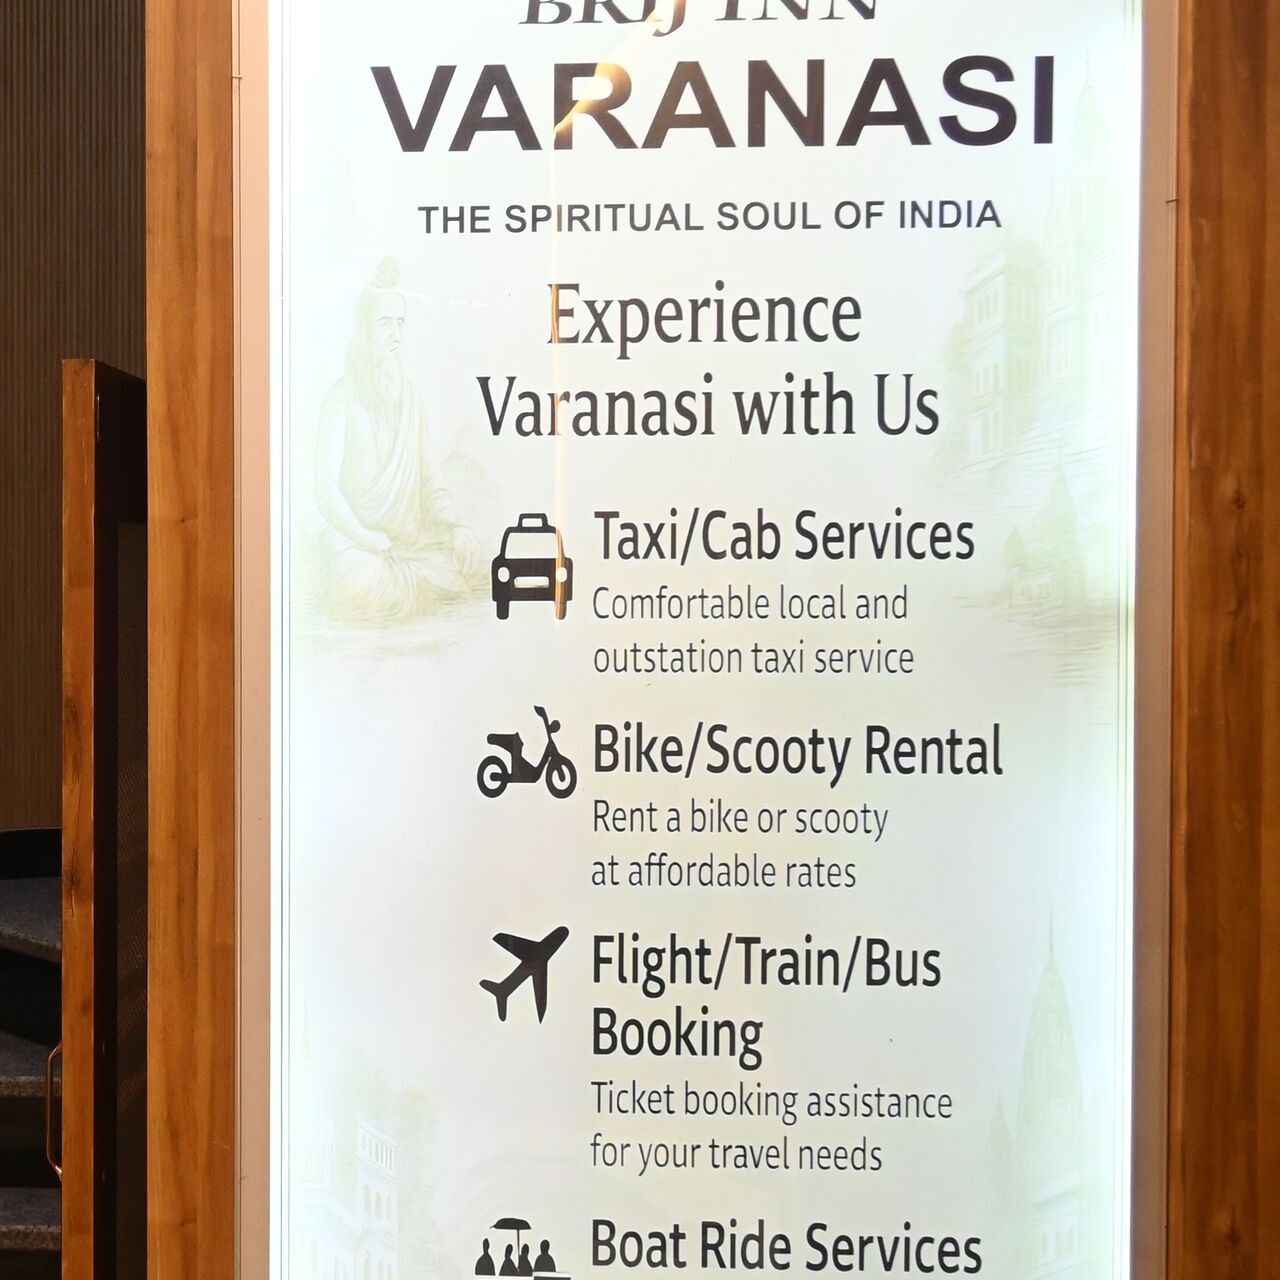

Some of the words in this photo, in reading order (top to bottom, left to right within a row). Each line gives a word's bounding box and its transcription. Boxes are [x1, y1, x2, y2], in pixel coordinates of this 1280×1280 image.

[370, 55, 1054, 152] VARANASI
[418, 206, 491, 233] THE
[505, 203, 704, 233] SPIRITUAL
[717, 202, 821, 230] SOUL
[835, 201, 885, 229] OF
[900, 200, 1002, 228] INDIA
[547, 280, 861, 360] Experience
[476, 372, 715, 437] Varanasi
[732, 371, 856, 435] with
[874, 374, 939, 435] Us
[594, 507, 781, 566] Taxi/Cab
[795, 507, 974, 560] Services
[593, 584, 769, 619] Comfortable
[781, 584, 846, 619] local
[856, 584, 907, 619] and
[594, 639, 742, 673] outstation
[751, 639, 803, 673] taxi
[815, 639, 914, 673] service
[595, 721, 852, 789] Bike/Scooty
[866, 723, 1003, 775] Rental
[594, 800, 658, 832] Rent
[667, 808, 680, 832] a
[691, 798, 748, 833] bike
[758, 809, 787, 833] or
[795, 803, 888, 842] scooty
[592, 855, 620, 886] at
[629, 852, 776, 887] affordable
[787, 857, 856, 887] rates
[594, 932, 941, 998] Flight/Train/Bus
[593, 1005, 763, 1071] Booking
[591, 1080, 675, 1114] Ticket
[685, 1080, 798, 1126] booking
[807, 1083, 952, 1118] assistance
[590, 1133, 631, 1166] for
[639, 1144, 701, 1176] your
[708, 1136, 789, 1169] travel
[799, 1138, 882, 1171] needs
[592, 1219, 687, 1268] Boat
[701, 1218, 791, 1270] Ride
[806, 1221, 982, 1274] Services
